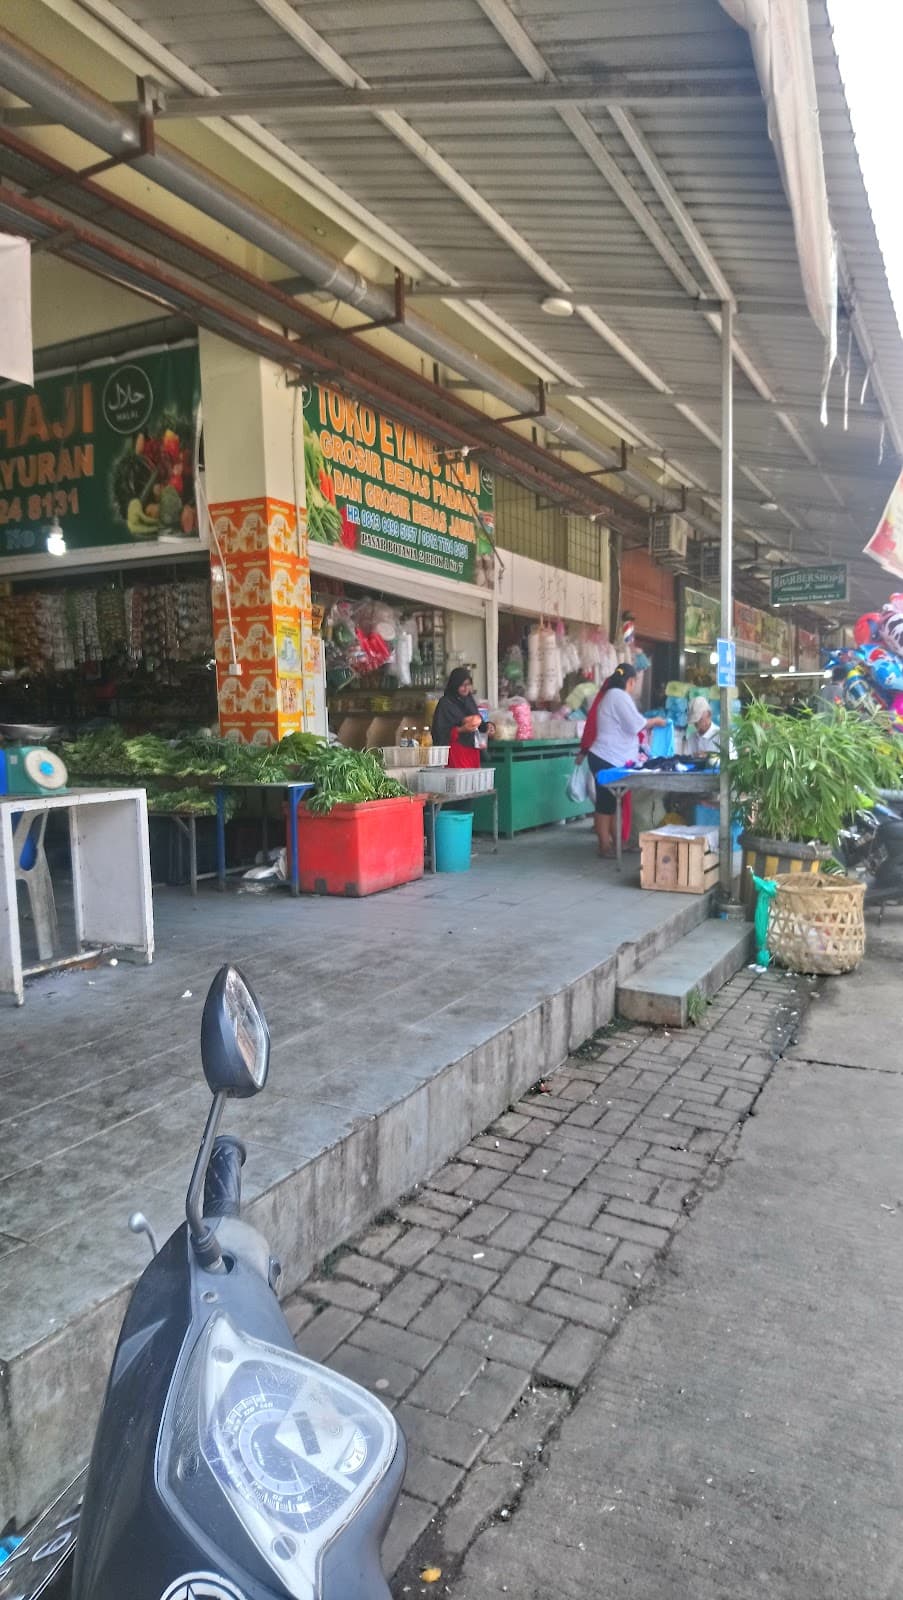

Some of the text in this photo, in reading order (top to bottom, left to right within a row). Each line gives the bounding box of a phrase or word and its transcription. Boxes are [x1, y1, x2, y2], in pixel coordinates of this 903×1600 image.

[318, 383, 376, 446] TOKO
[0, 443, 95, 490] YURAN
[319, 430, 382, 480] GROSIR
[383, 457, 431, 500] BERAS
[334, 469, 363, 504] DAN
[364, 482, 411, 521] GROSIR
[412, 500, 447, 534] BERAS
[346, 503, 361, 525] HP.
[361, 510, 381, 532] 0813
[360, 533, 387, 551] PASAR
[418, 549, 425, 563] 2
